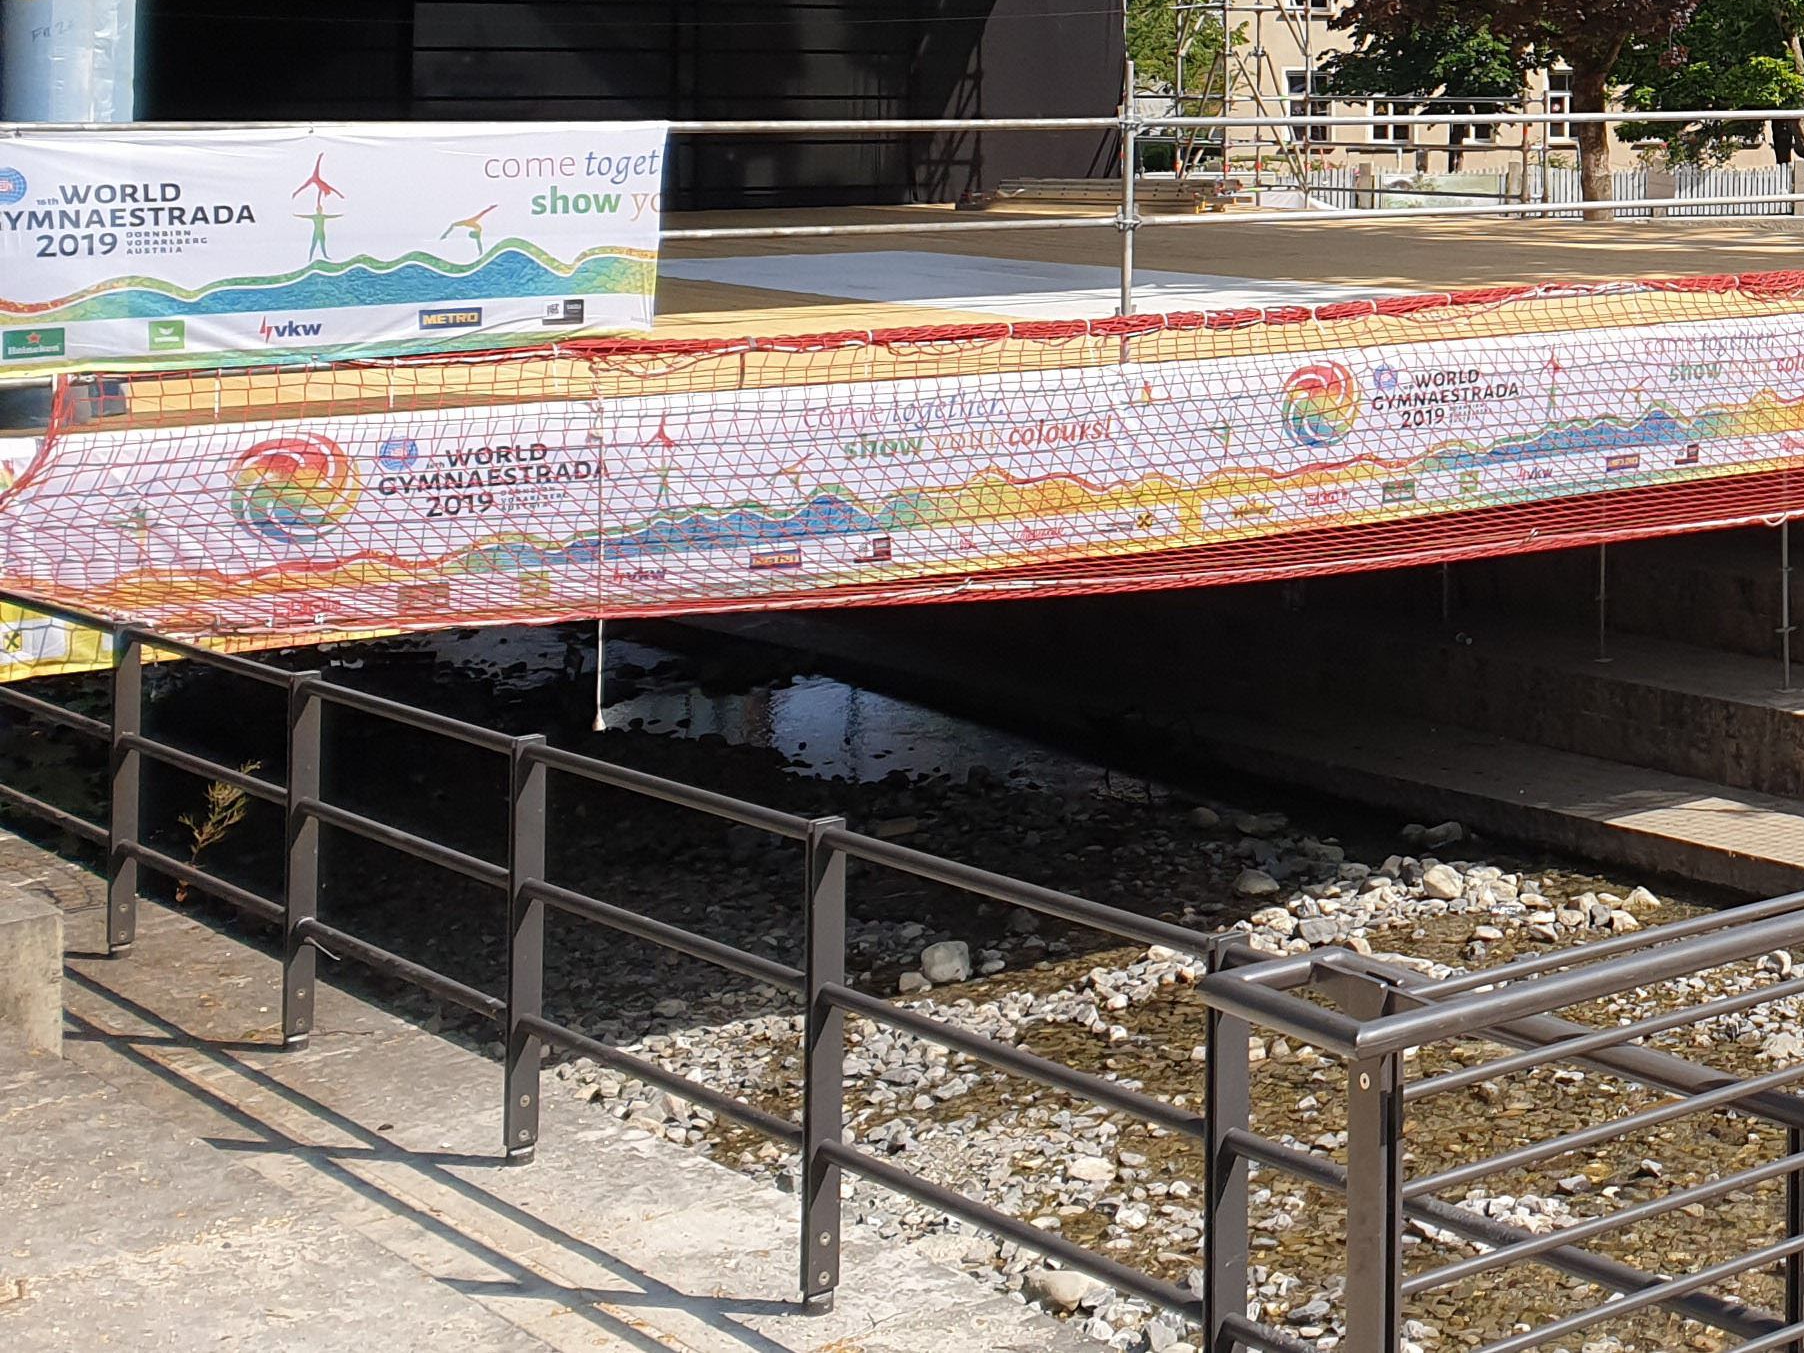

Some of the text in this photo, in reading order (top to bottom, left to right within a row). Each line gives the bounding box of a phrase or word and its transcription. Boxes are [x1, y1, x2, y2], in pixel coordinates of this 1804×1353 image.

[484, 148, 660, 185] come toget
[59, 182, 182, 205] WORLD
[531, 185, 622, 215] show
[36, 232, 118, 258] 2019
[126, 230, 192, 239] DORNBIRN
[126, 237, 208, 246] VORARLBERG
[126, 247, 183, 255] AUSTRIA
[274, 320, 323, 338] vkw
[423, 312, 479, 326] METRO
[1415, 368, 1480, 389] WORLD
[1372, 382, 1519, 411] GYMNAESTRADA
[1402, 408, 1445, 428] 2019
[446, 442, 548, 468] WORLD
[378, 461, 609, 496] GYMNAESTRADA
[426, 493, 494, 518] 2019
